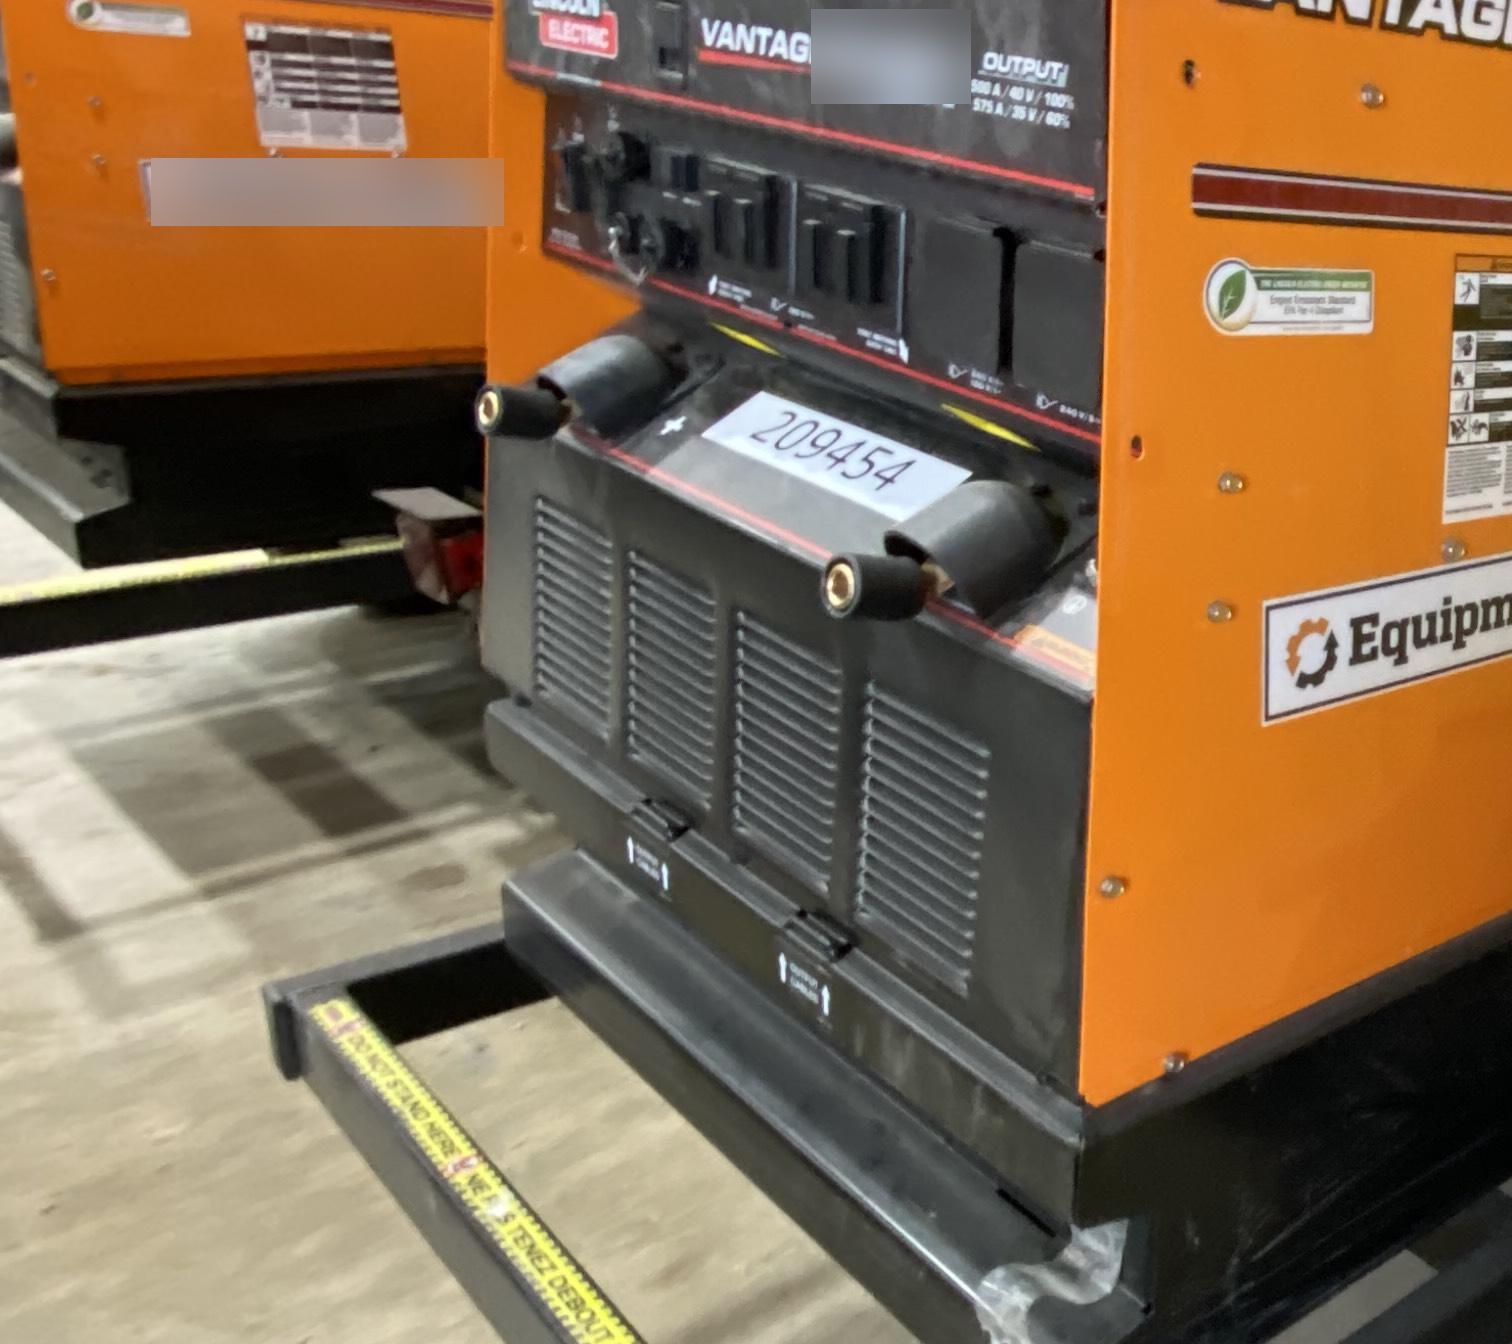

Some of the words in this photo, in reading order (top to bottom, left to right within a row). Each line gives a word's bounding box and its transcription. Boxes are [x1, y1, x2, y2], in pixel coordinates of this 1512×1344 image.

[547, 18, 610, 49] ELECTRIC
[701, 18, 812, 65] VANTAG
[981, 50, 1064, 81] OUTPUT
[749, 411, 918, 492] 209454
[508, 1224, 559, 1277] TENEZ
[548, 1274, 615, 1344] DEBOUT
